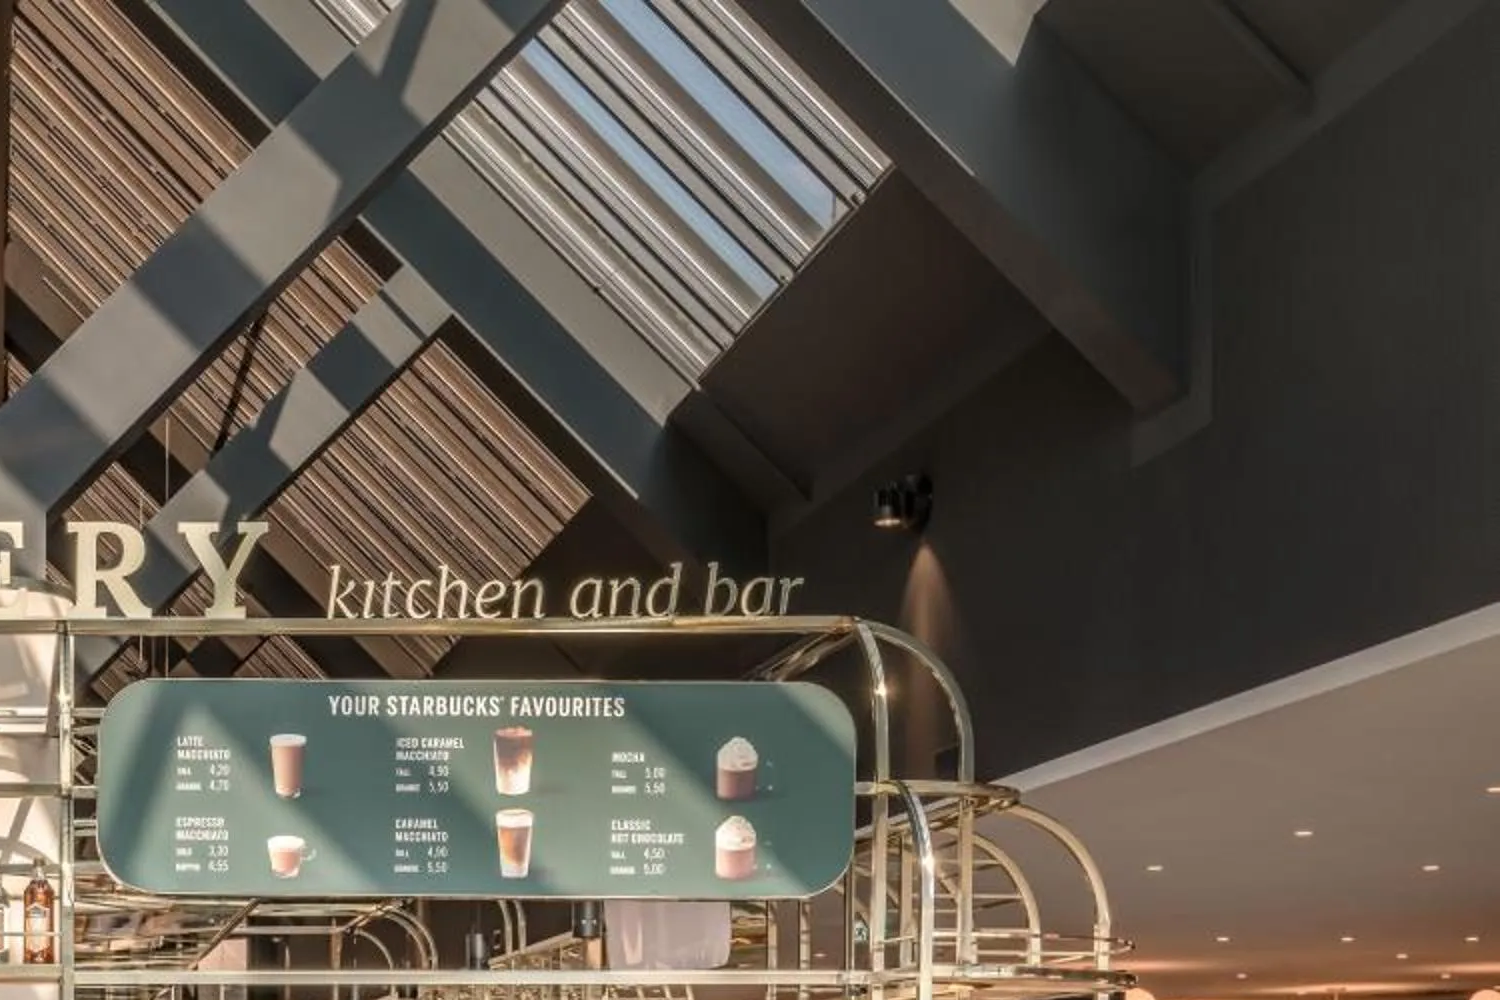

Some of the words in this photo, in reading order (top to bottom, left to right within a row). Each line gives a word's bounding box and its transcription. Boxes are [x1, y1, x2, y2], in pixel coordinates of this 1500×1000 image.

[327, 564, 544, 619] kitchen
[570, 561, 683, 616] and
[703, 561, 803, 617] bar
[329, 696, 379, 716] YOUR
[511, 696, 624, 716] FAVOURITES
[421, 738, 465, 748] CARAMEL
[611, 752, 645, 762] MOCHA
